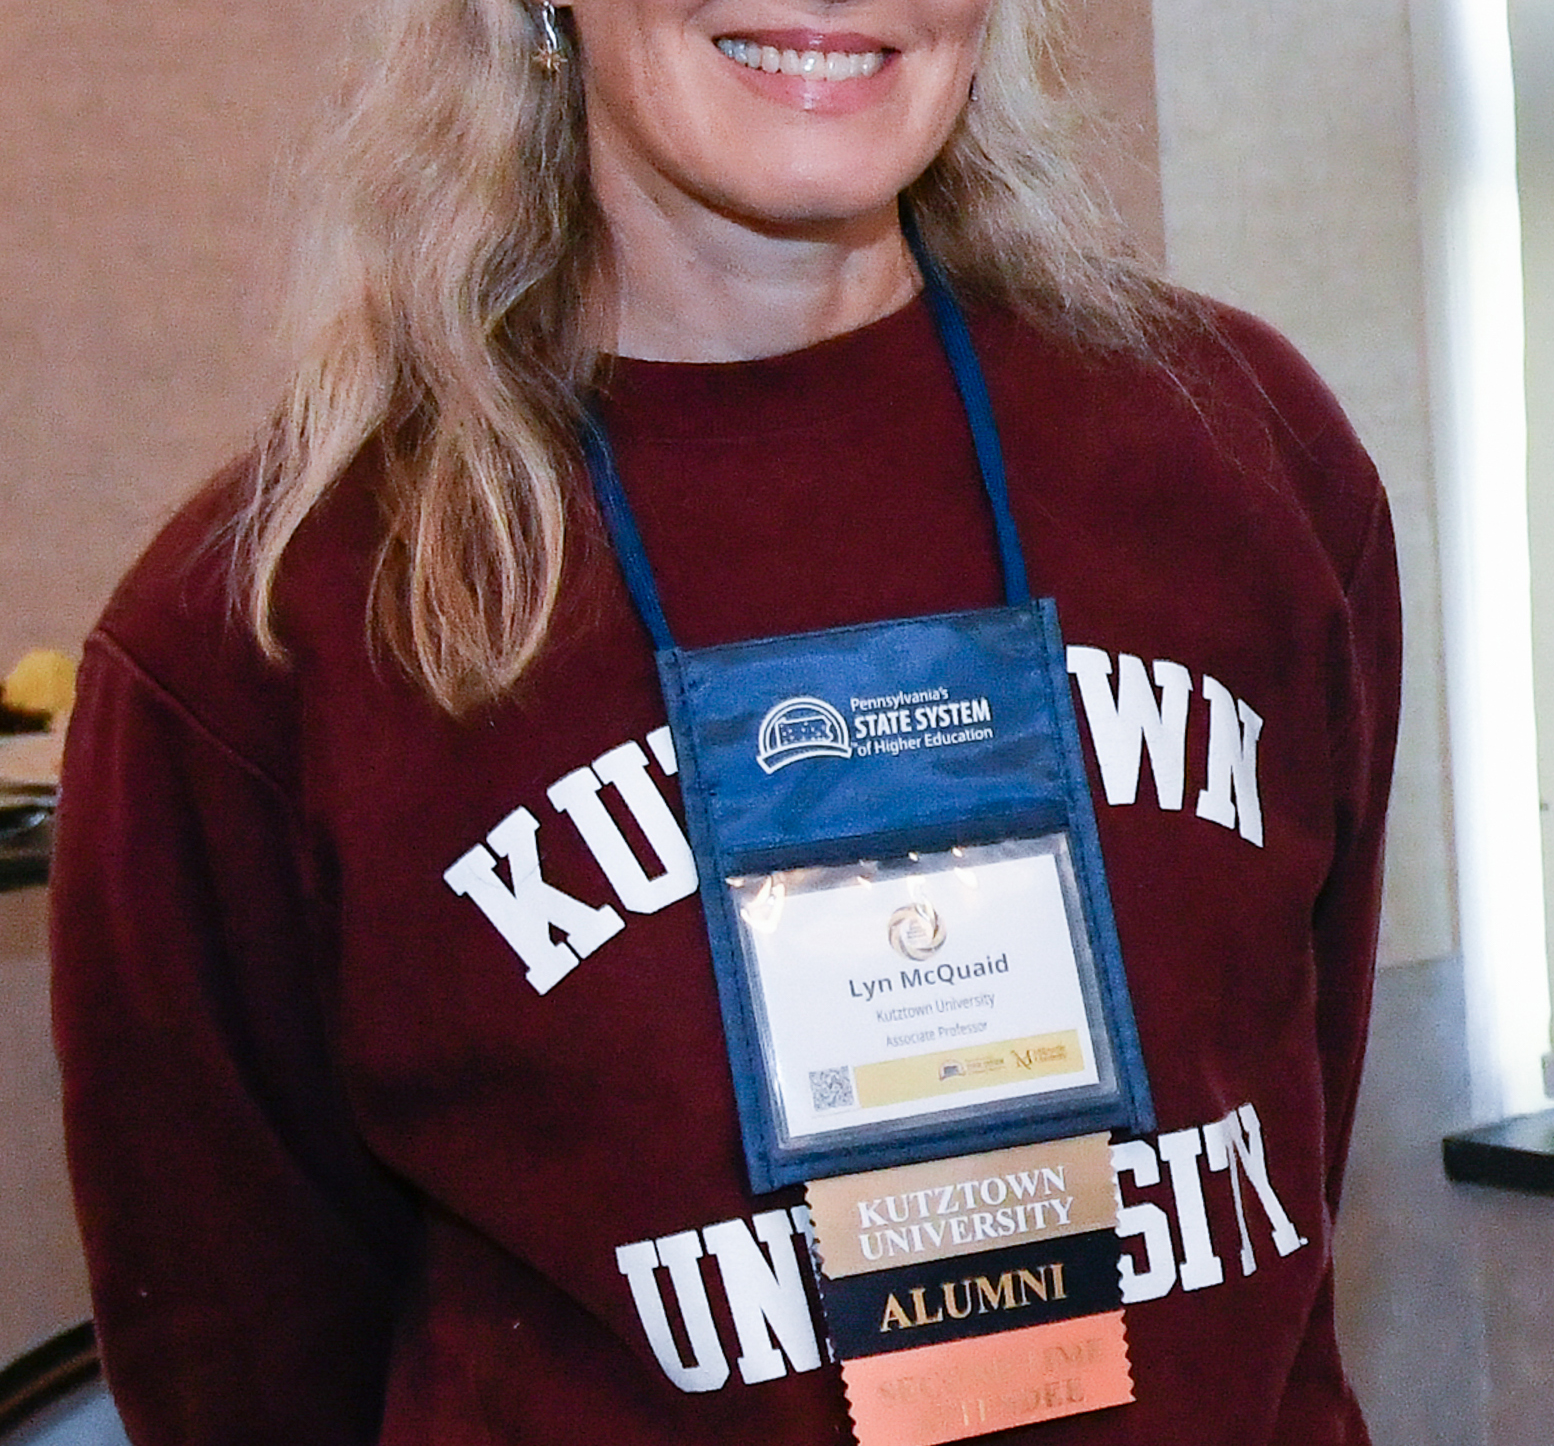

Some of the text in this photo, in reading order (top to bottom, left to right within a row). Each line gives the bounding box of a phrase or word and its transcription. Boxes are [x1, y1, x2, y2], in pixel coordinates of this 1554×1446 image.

[850, 686, 948, 712] Pennsylvania's
[855, 697, 991, 738] STATE SYSTEM
[857, 728, 993, 759] of Higher Education
[849, 953, 1009, 1001] Lyn McQuaid
[876, 994, 995, 1022] Kutztown University
[886, 1022, 987, 1047] Associate Professor
[858, 1165, 1065, 1228] KUTZTOWN
[859, 1196, 1073, 1260] UNIVERSITY
[880, 1264, 1067, 1332] ALUMNI
